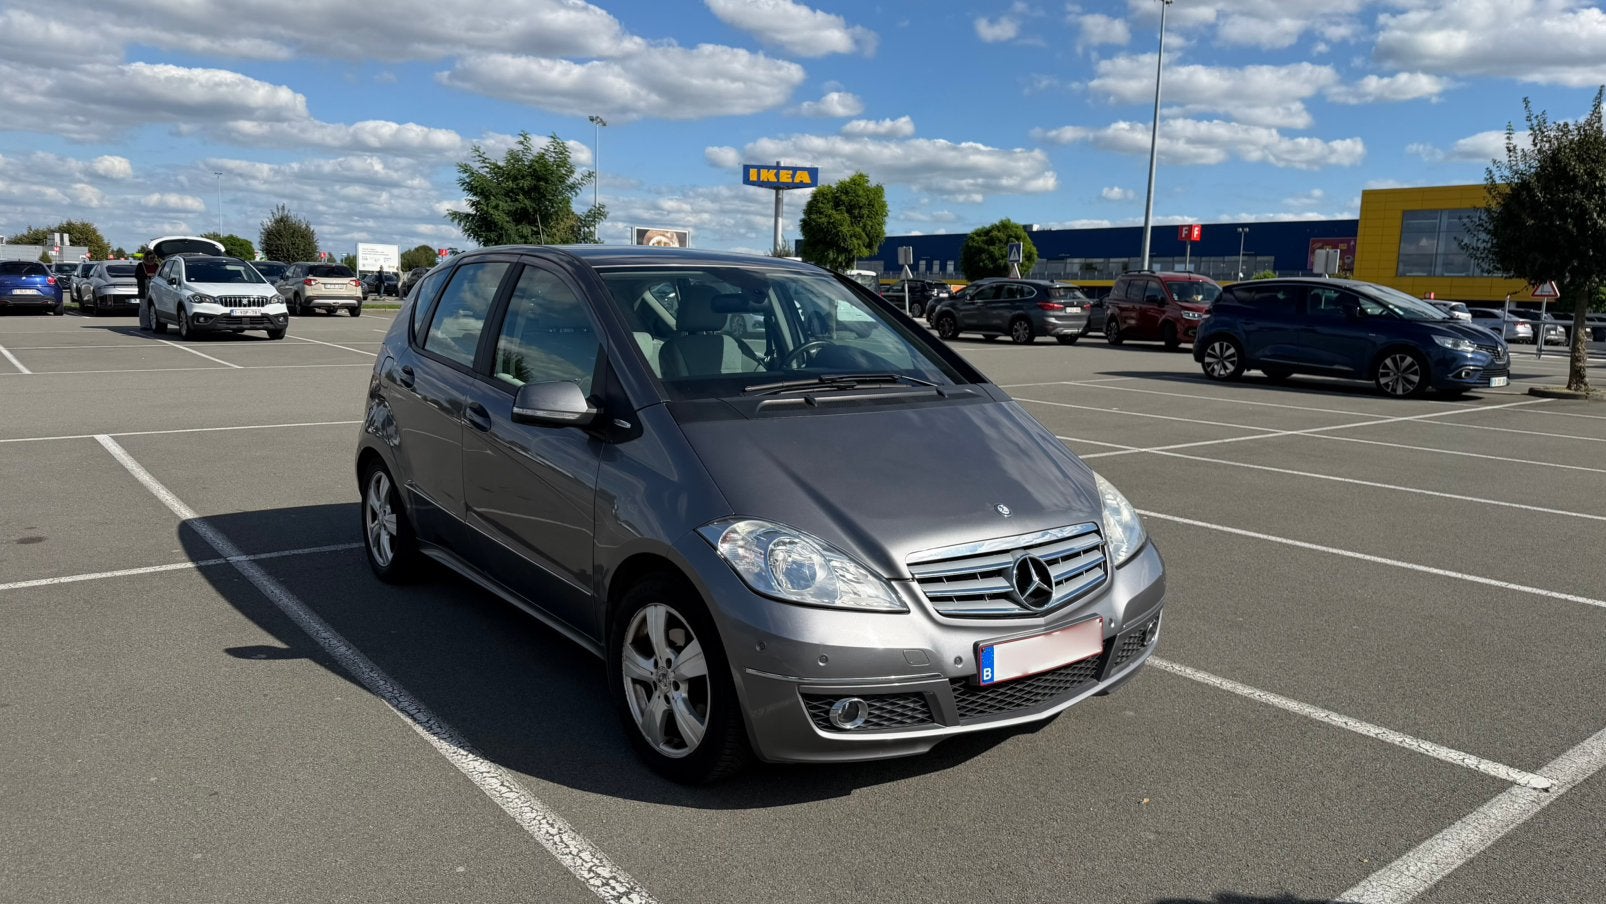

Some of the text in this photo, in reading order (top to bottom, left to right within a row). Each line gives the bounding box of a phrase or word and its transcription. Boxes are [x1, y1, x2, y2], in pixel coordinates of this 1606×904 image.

[749, 168, 812, 184] IKEA
[1182, 226, 1189, 238] F
[1193, 226, 1199, 238] F
[983, 667, 992, 681] B
